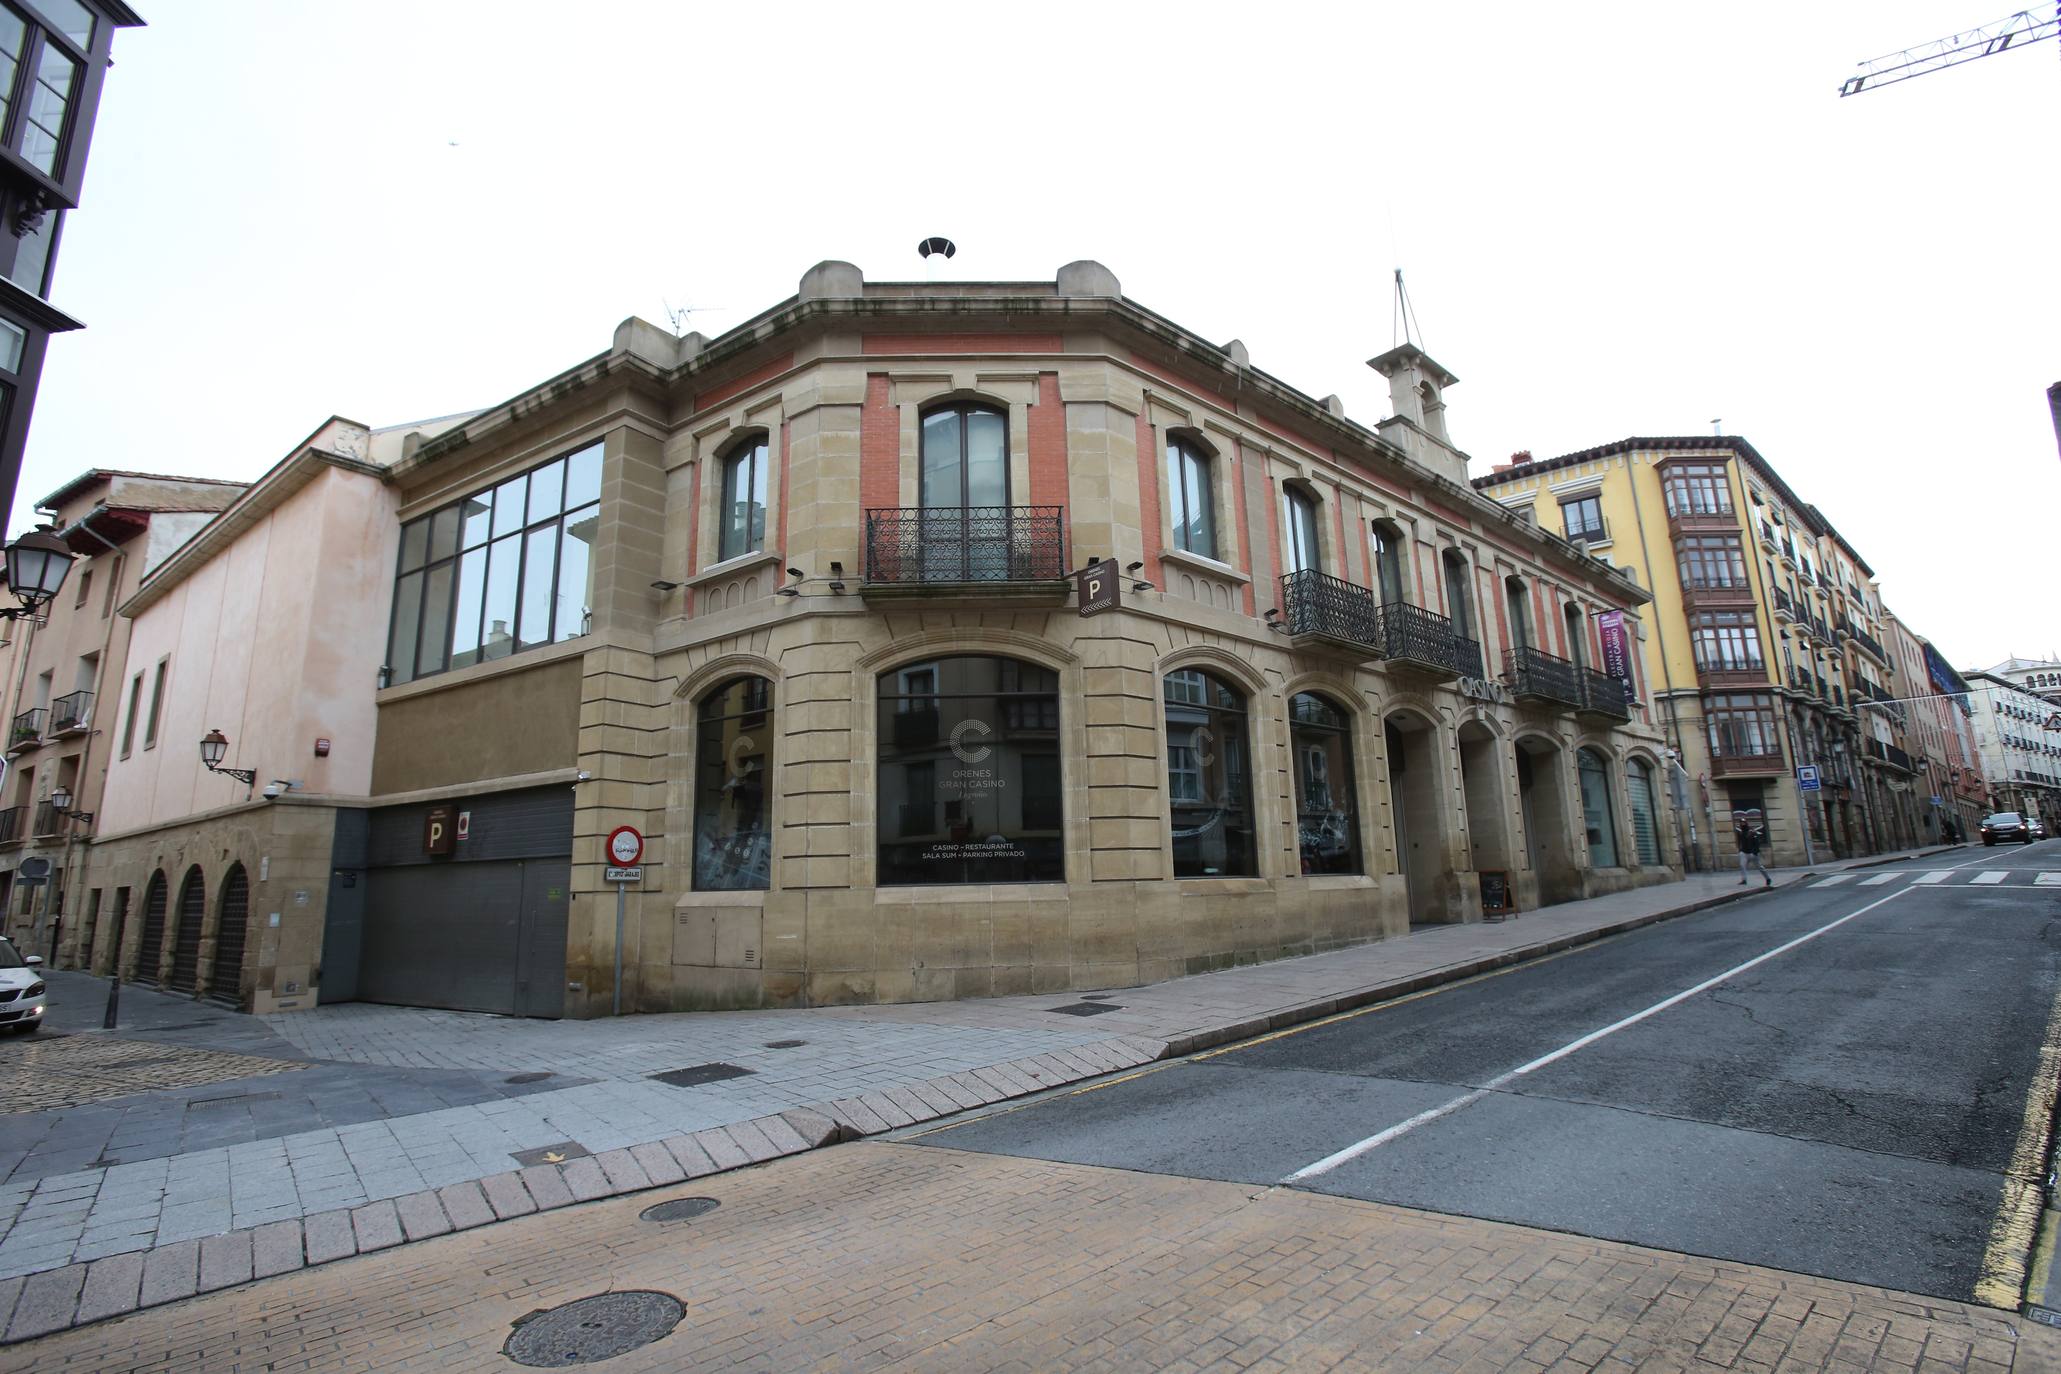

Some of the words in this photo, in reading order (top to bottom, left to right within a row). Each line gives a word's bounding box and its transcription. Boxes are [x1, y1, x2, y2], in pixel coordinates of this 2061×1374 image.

[1090, 580, 1100, 600] P
[1611, 628, 1622, 655] CASINO
[1615, 655, 1625, 677] GRAN
[1457, 676, 1505, 704] CASINO
[939, 780, 967, 789] GRAN
[968, 779, 1006, 789] CASINO
[952, 769, 992, 778] ORENES
[430, 823, 442, 848] P
